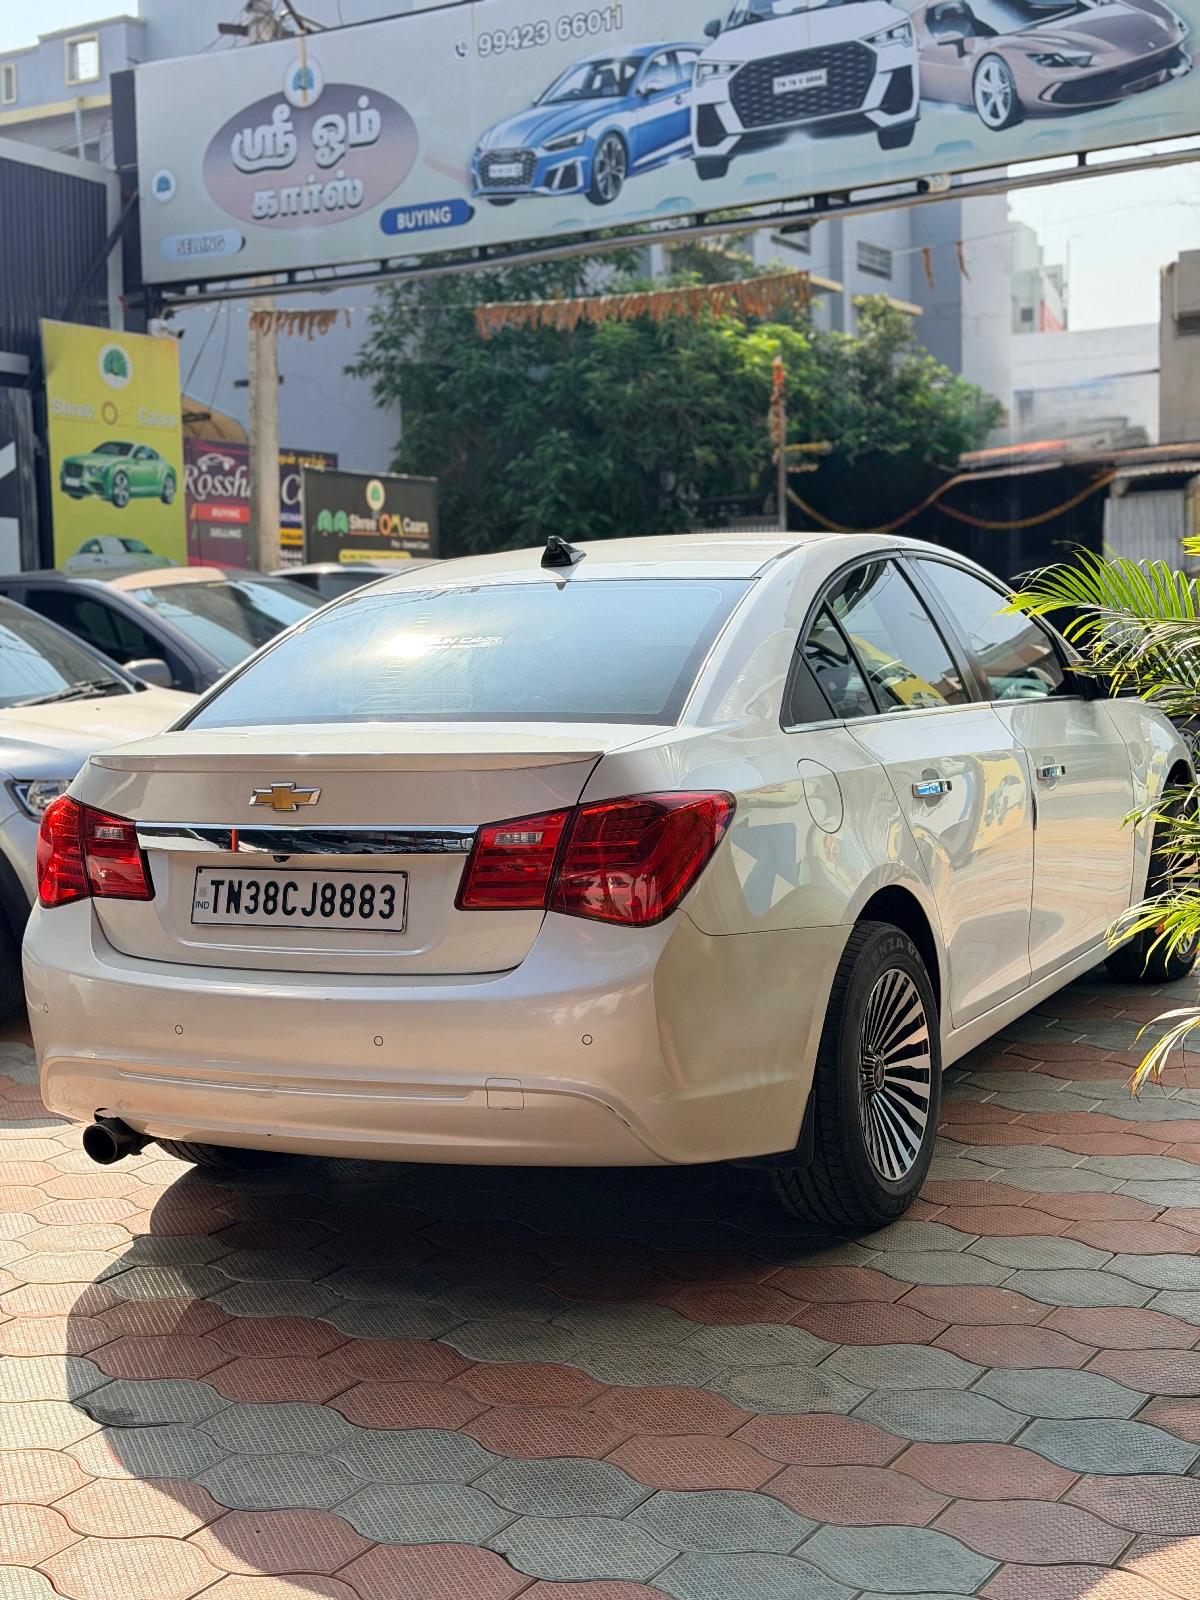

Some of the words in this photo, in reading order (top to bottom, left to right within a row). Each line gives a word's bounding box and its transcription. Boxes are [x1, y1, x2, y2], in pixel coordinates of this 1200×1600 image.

[477, 20, 550, 58] 99423
[556, 4, 622, 41] 66011
[250, 169, 364, 220] கார்ஸ்
[397, 205, 452, 230] BUYING
[175, 234, 226, 256] SELLING
[51, 397, 94, 419] Shree
[136, 407, 177, 428] Caars
[211, 507, 241, 519] BUYING
[349, 513, 378, 532] Shree
[209, 526, 242, 539] SELLING
[195, 901, 210, 910] IND
[210, 879, 396, 919] TN38CJ8883
